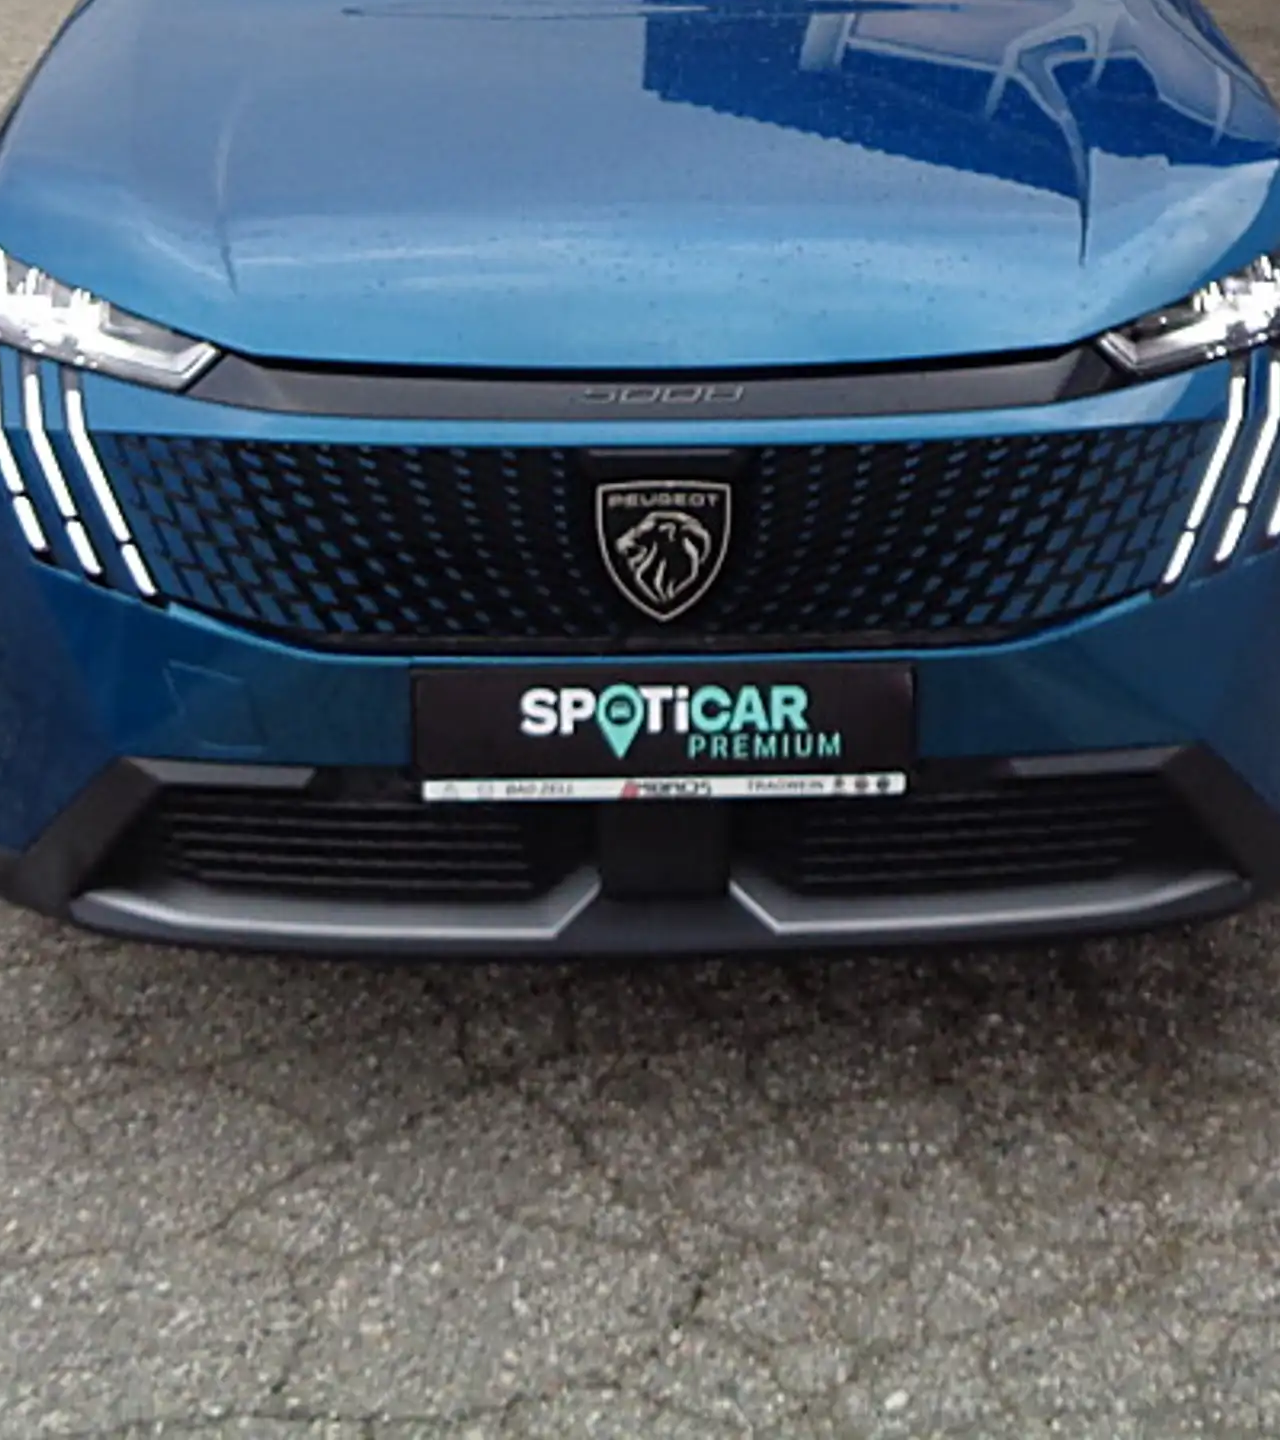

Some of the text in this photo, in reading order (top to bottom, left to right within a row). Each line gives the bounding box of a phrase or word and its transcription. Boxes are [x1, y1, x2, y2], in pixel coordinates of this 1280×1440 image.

[582, 384, 744, 405] 5008
[608, 492, 720, 508] PEUGEOT
[687, 732, 841, 758] PREMIUM
